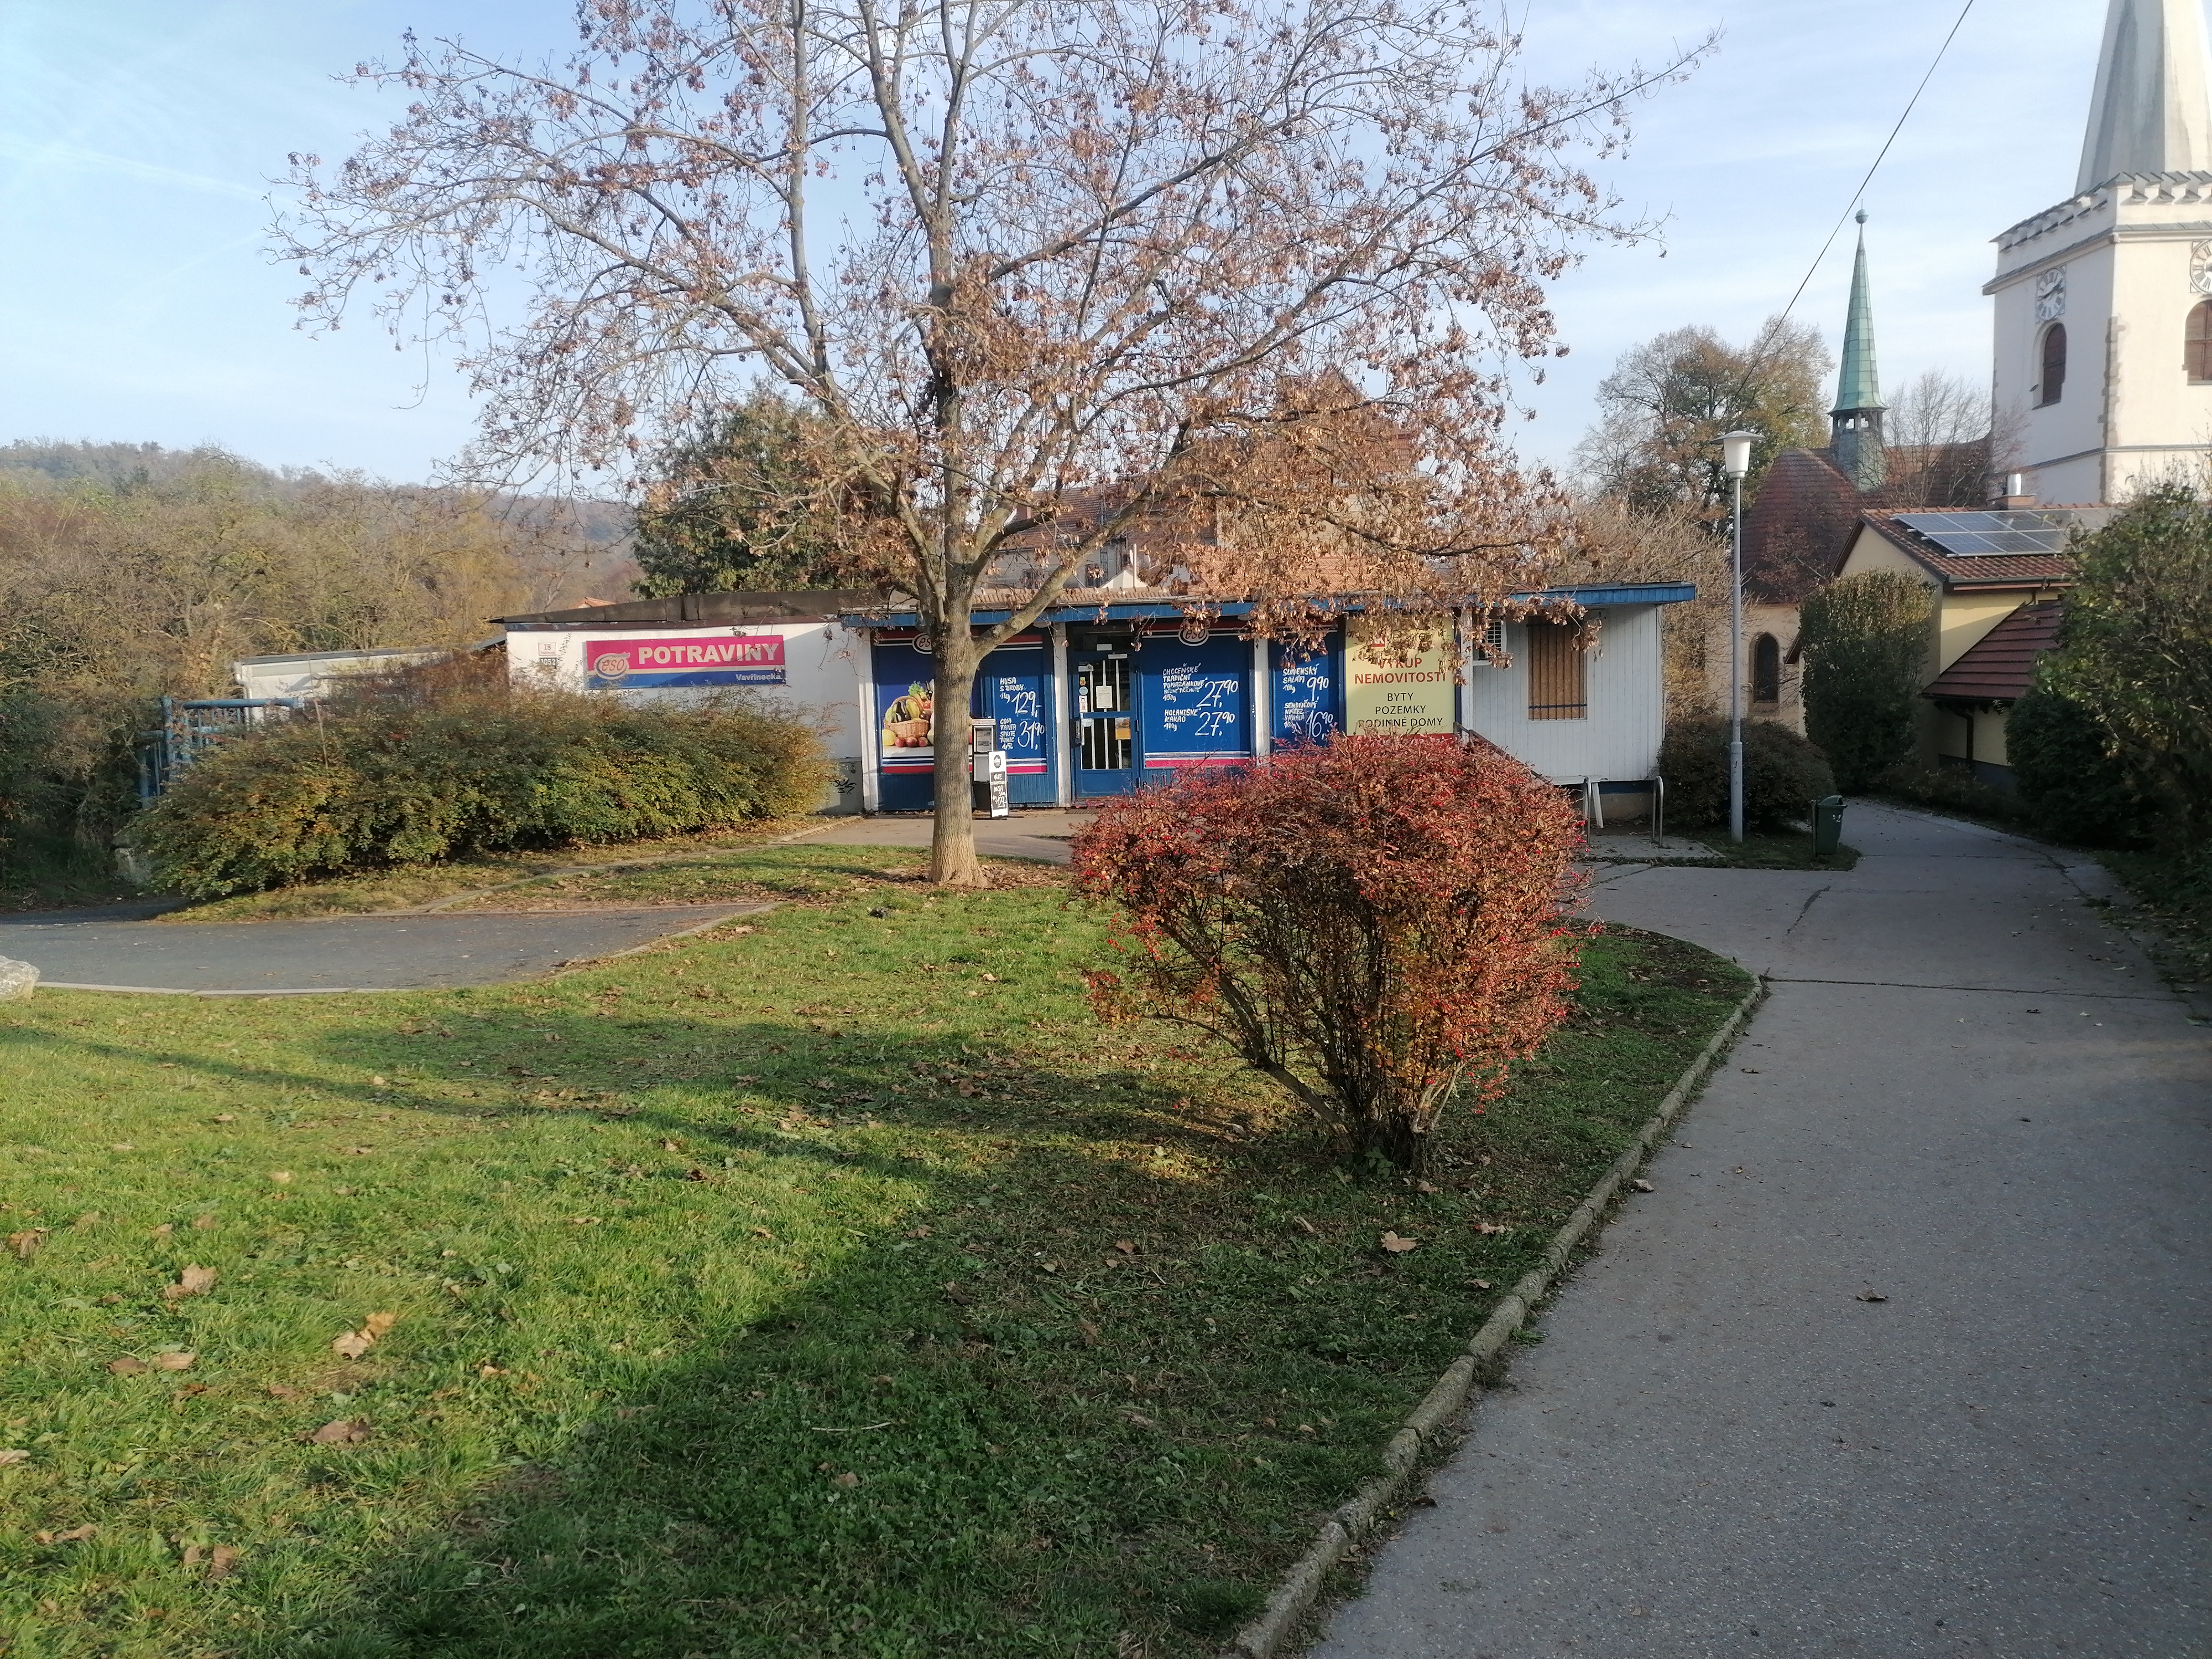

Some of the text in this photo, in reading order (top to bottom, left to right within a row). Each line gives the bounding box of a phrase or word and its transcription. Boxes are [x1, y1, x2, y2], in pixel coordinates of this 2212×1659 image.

[1186, 629, 1206, 639] eso
[919, 638, 931, 647] es
[638, 643, 779, 664] POTRAVINY
[602, 659, 625, 671] eso
[1387, 692, 1413, 701] BYTY
[1375, 705, 1426, 714] POZEMKY
[1411, 718, 1443, 727] DOMY
